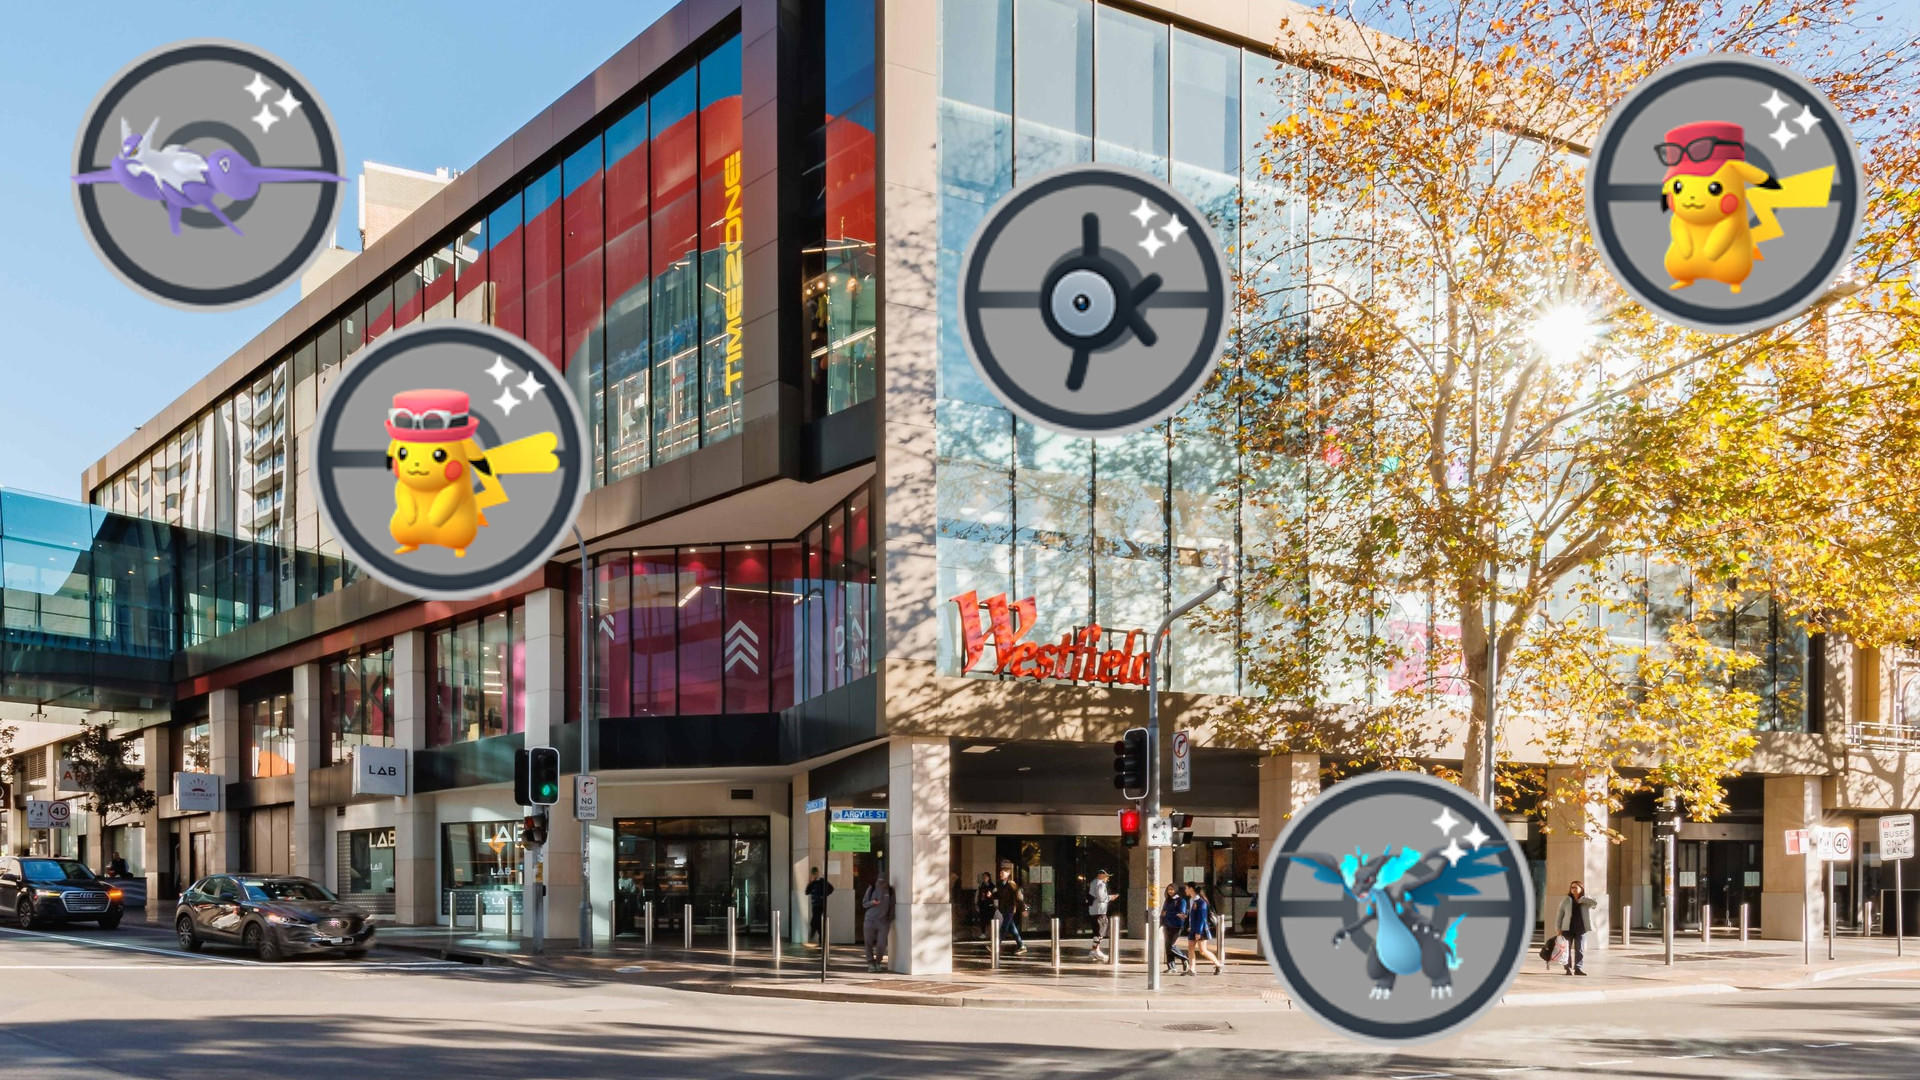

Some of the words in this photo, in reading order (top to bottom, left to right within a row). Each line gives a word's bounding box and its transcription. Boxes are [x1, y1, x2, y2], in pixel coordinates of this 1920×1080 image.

[724, 150, 743, 396] TIMEZONE
[949, 589, 1170, 686] Westfield
[1176, 761, 1186, 770] NO
[369, 765, 397, 776] LAB
[581, 797, 593, 805] NO
[52, 807, 67, 816] 40
[843, 810, 873, 818] ARGYLE
[876, 810, 886, 818] ST
[1884, 830, 1909, 838] BUSES
[369, 831, 396, 847] LAB
[1836, 838, 1848, 849] 40
[1886, 839, 1908, 847] ONLY
[1887, 847, 1908, 855] LANE
[490, 867, 511, 875] LAB
